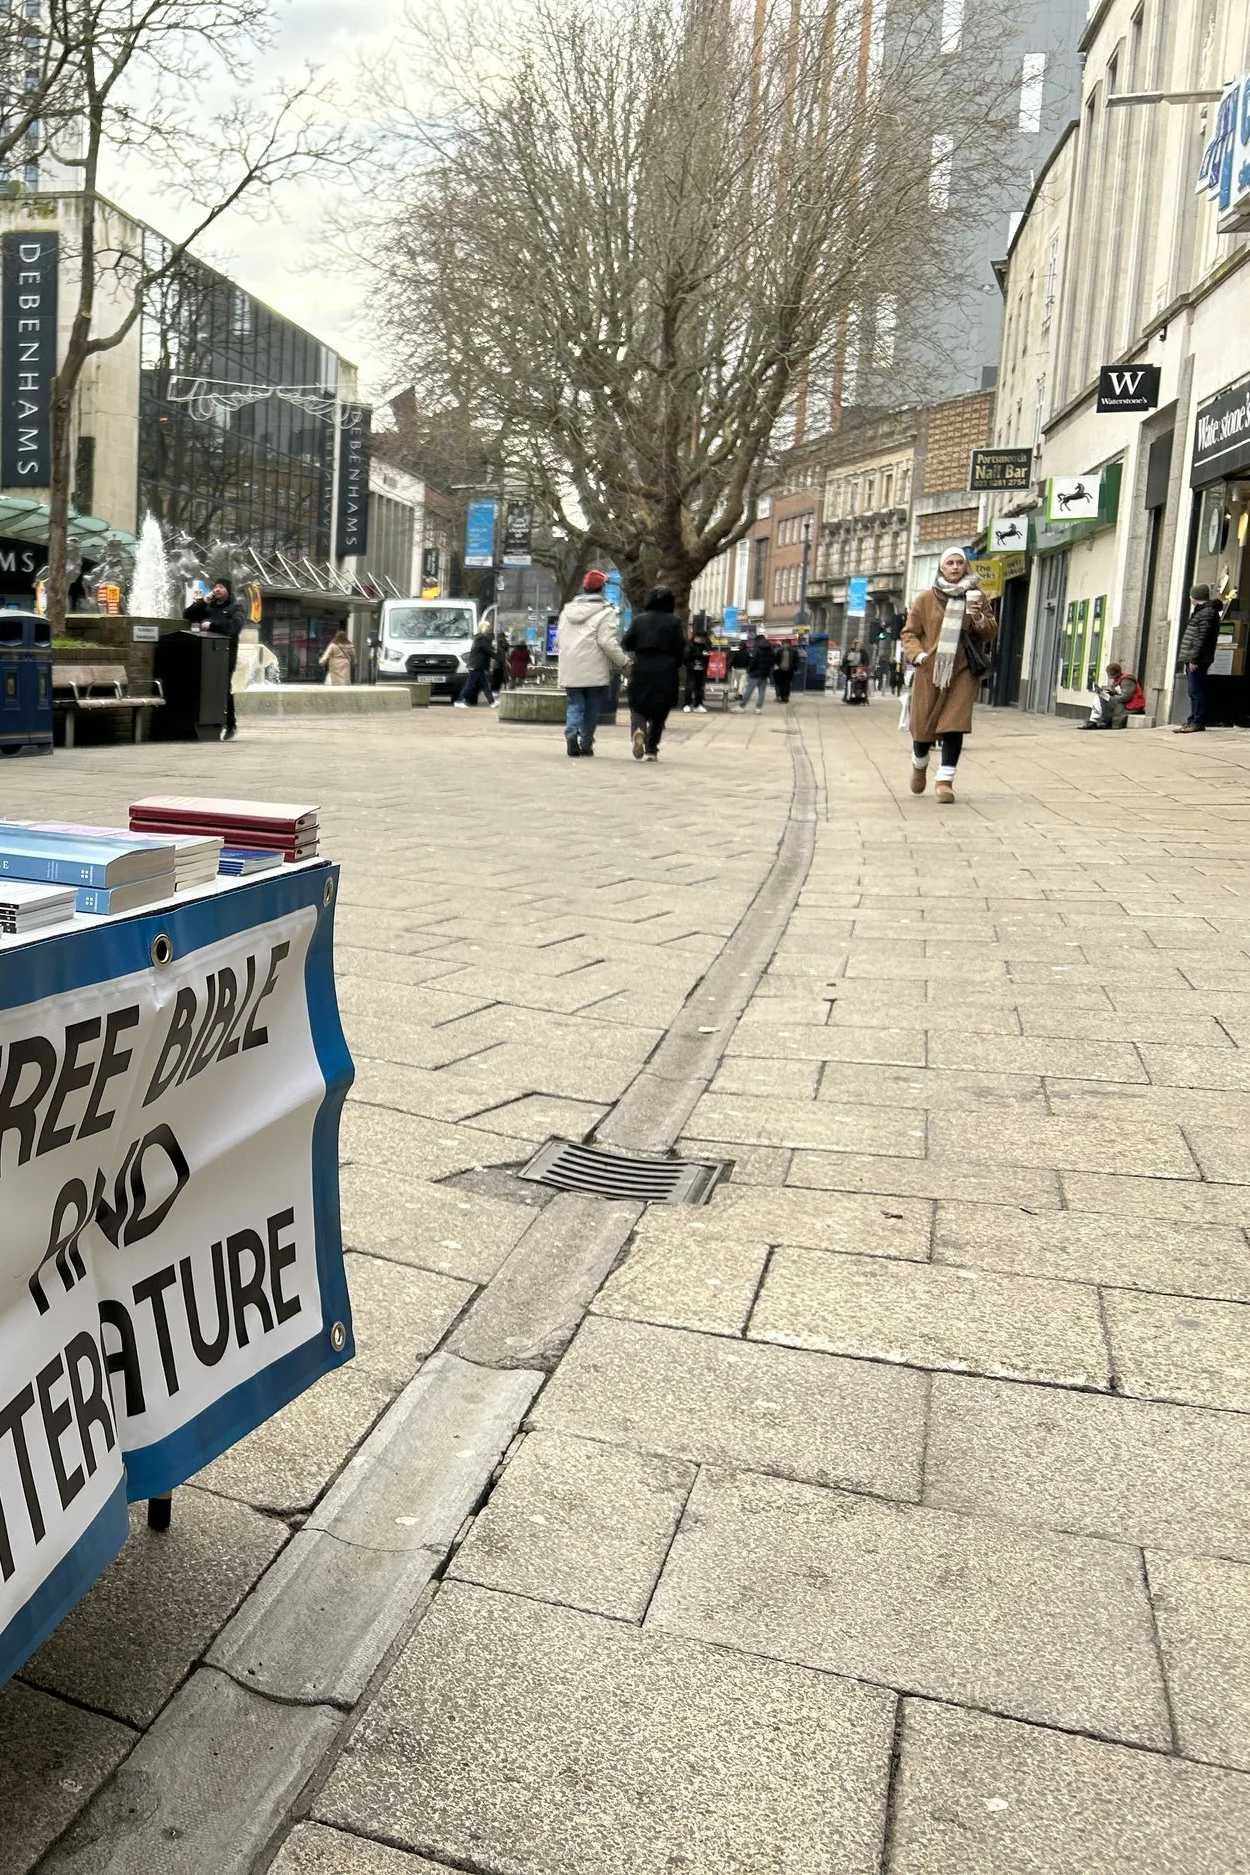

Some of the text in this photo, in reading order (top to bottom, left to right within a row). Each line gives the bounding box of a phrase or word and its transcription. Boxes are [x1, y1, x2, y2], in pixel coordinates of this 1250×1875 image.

[17, 244, 41, 475] DEBENHAMS
[1101, 396, 1148, 405] Waterstone's
[1108, 371, 1146, 396] W
[975, 464, 1028, 479] Nail Bar
[1198, 392, 1250, 453] Watestone's
[346, 410, 363, 546] DEBENHAMS
[143, 940, 290, 1108] BIBLE
[27, 1122, 190, 1316] AND
